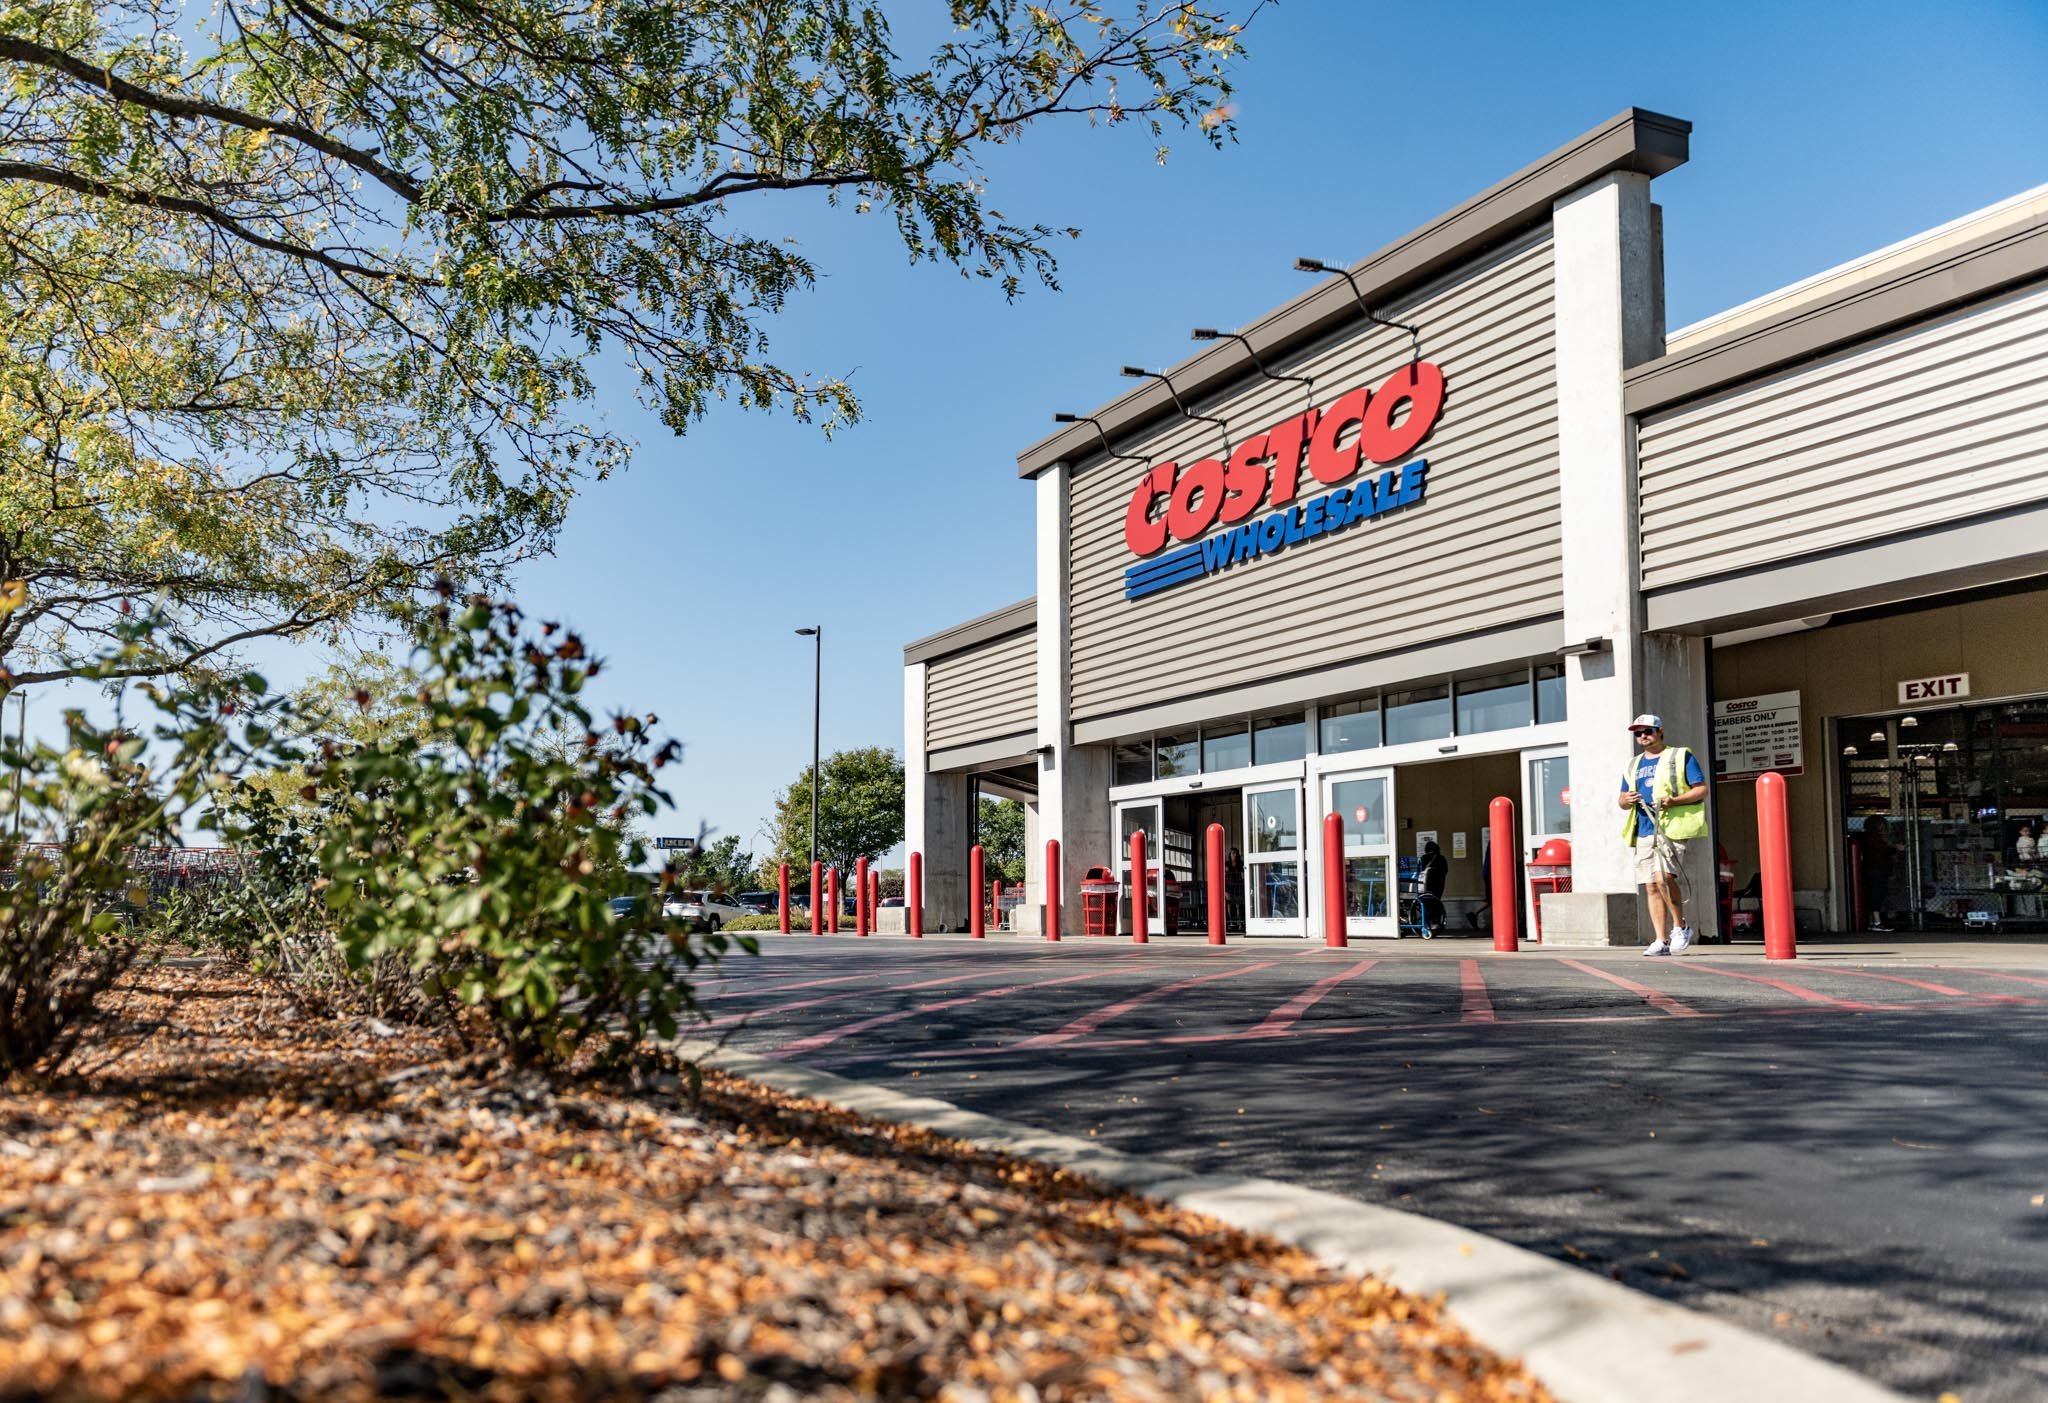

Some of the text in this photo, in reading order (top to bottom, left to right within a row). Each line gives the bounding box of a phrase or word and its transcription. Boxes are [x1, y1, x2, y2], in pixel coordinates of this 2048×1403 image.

[1125, 361, 1446, 556] COSTCO
[1201, 459, 1427, 573] WHOLESALE
[1906, 677, 1961, 700] EXIT
[1726, 700, 1758, 710] COSTCO
[1753, 711, 1777, 722] ONLY
